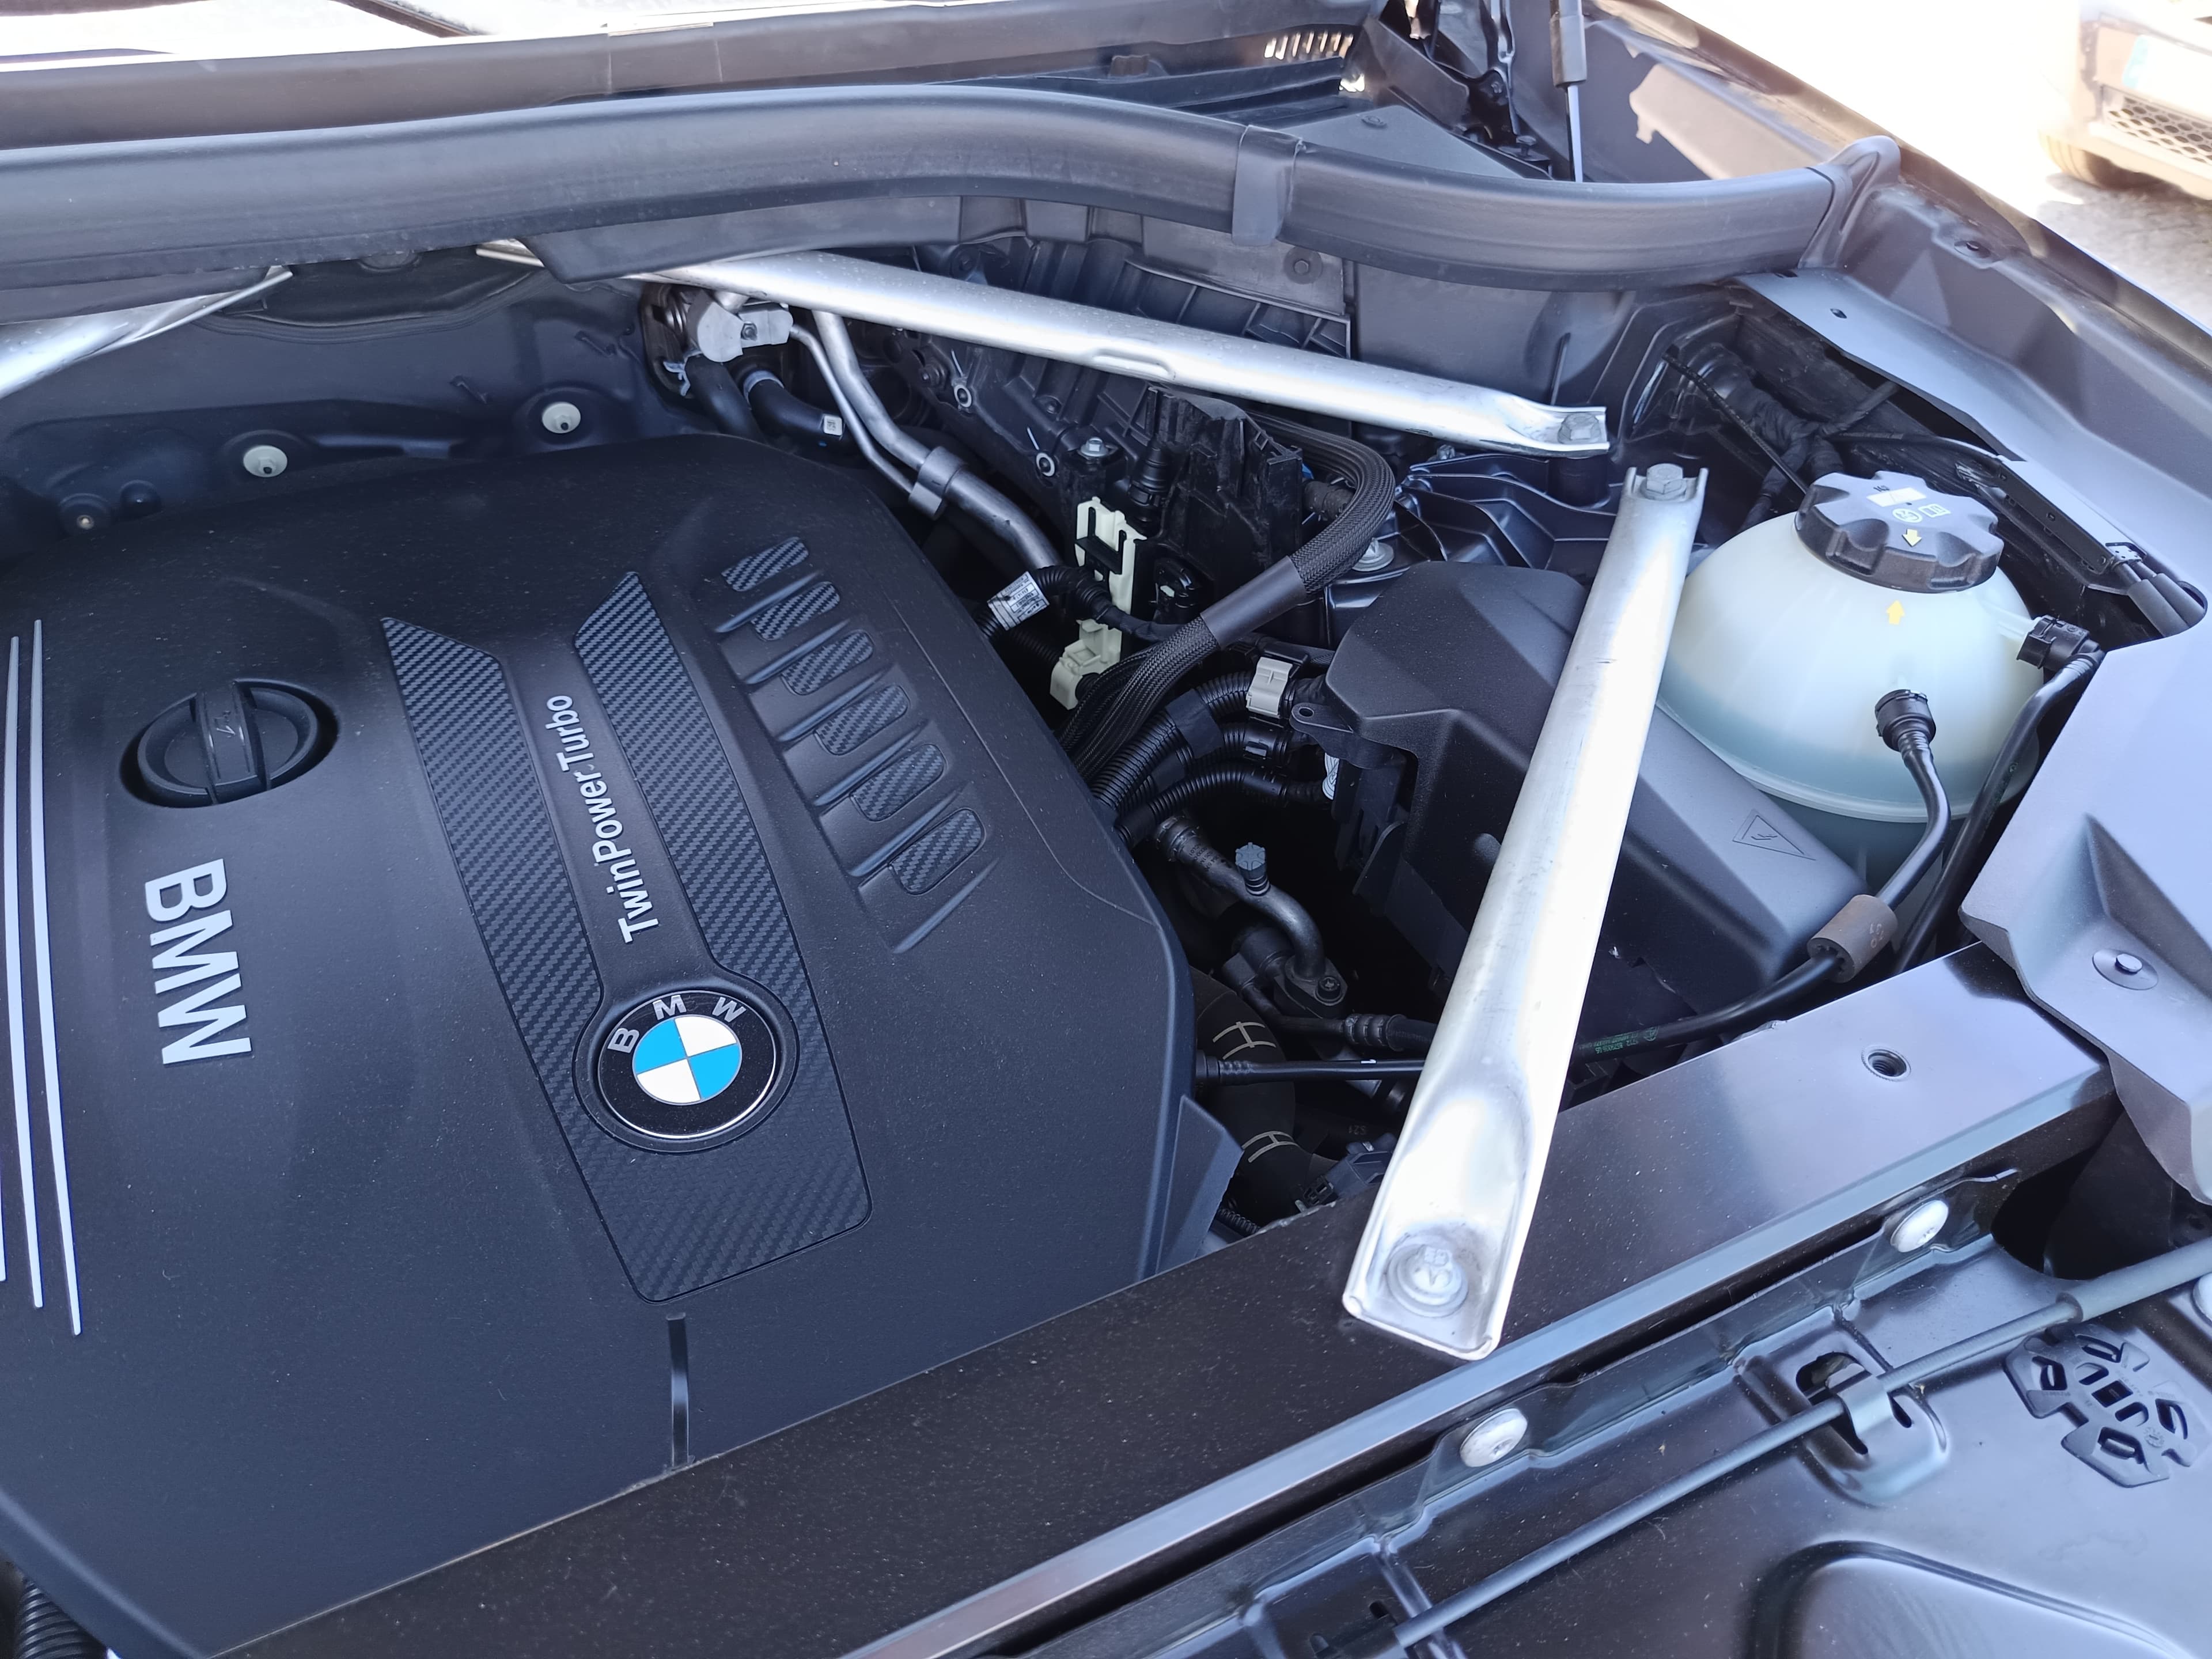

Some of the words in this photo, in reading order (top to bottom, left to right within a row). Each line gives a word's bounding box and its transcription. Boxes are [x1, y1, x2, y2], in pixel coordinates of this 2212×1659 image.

[545, 695, 594, 772] Turbo
[573, 772, 659, 944] TwinPower
[145, 858, 252, 1066] BMW
[608, 994, 746, 1055] BMW
